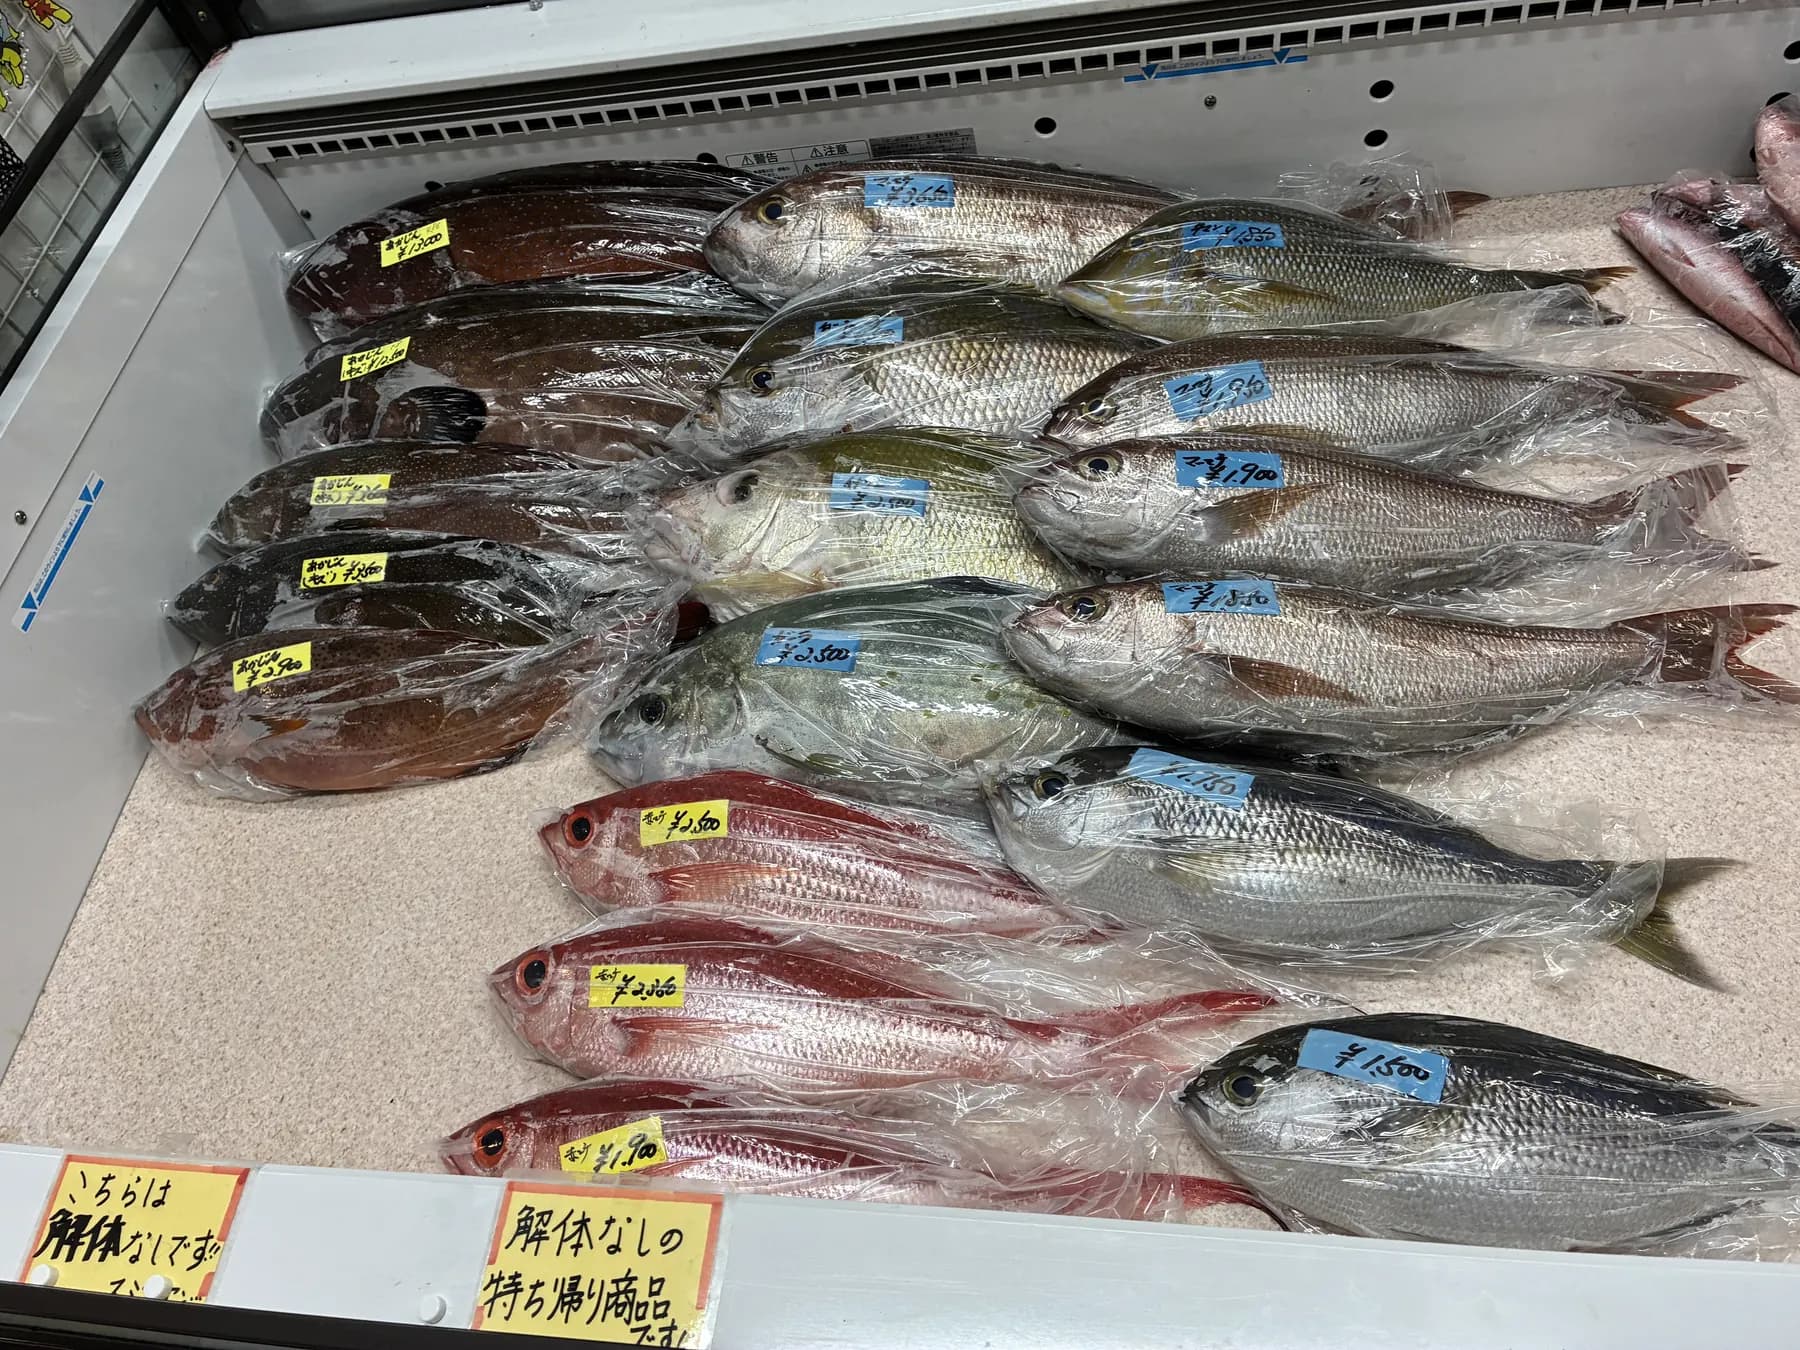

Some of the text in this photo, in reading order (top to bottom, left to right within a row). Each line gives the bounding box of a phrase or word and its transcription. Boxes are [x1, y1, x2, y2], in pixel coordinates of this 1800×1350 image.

[753, 152, 778, 165] 警告
[823, 143, 849, 156] 注意
[68, 1169, 172, 1208] こちらは
[504, 1203, 684, 1258] 解体なしの
[482, 1267, 671, 1326] 持ち帰り商品
